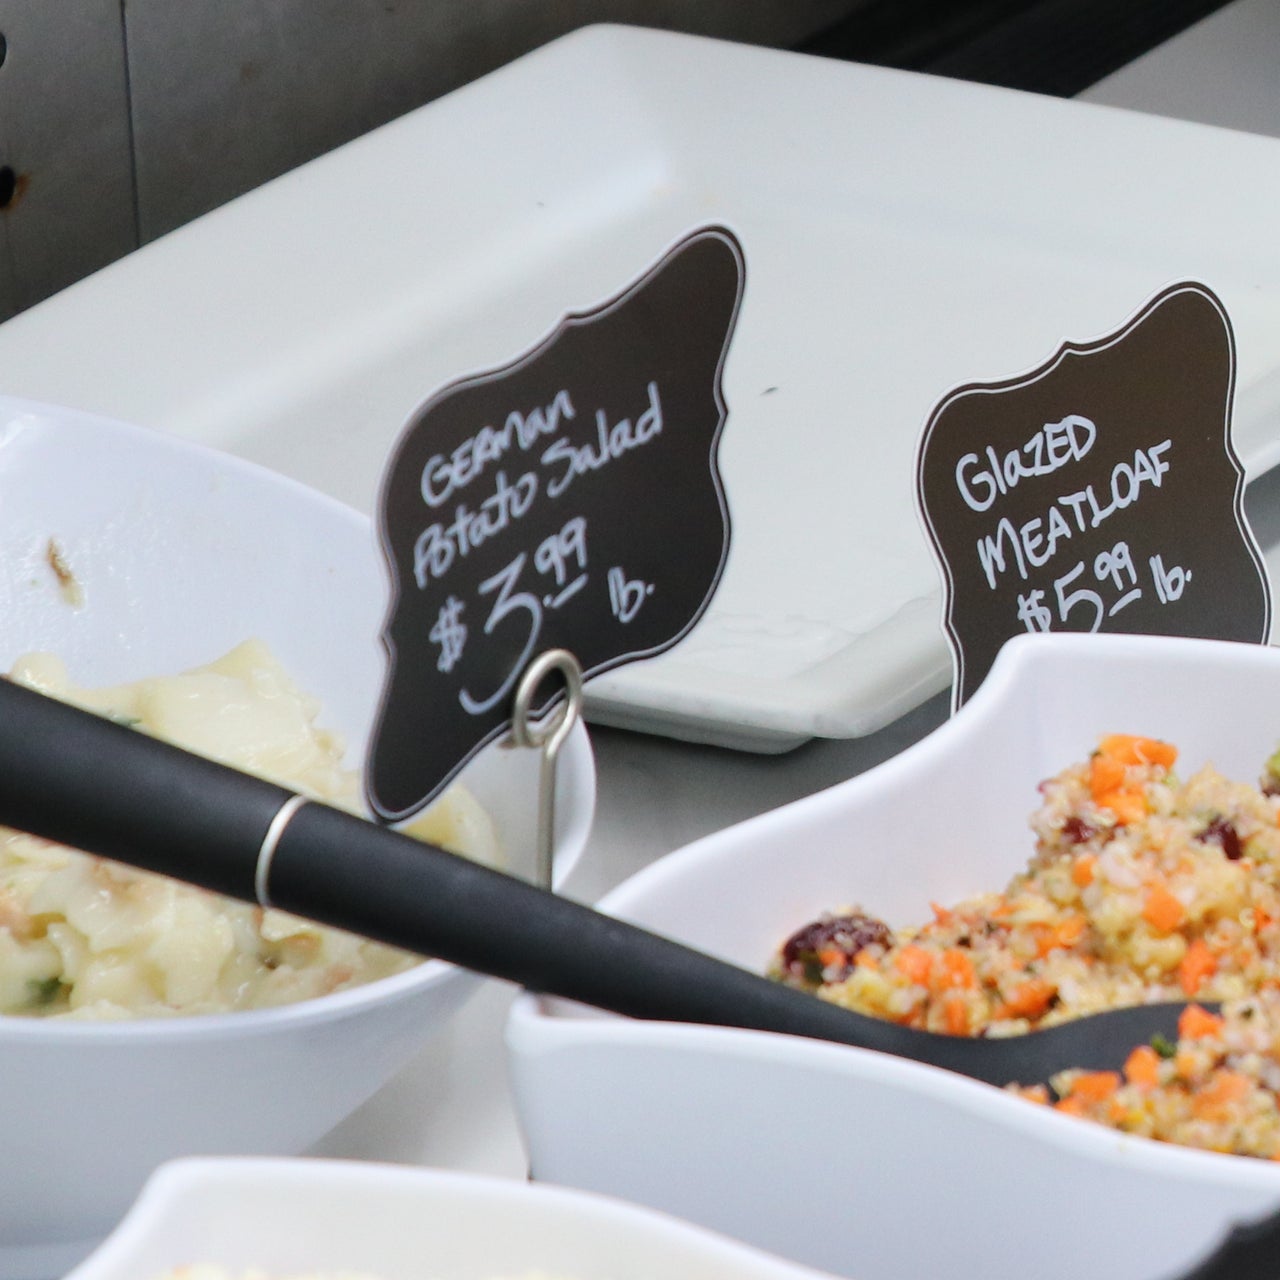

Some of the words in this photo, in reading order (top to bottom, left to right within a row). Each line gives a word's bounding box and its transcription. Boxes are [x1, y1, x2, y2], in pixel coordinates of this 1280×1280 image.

[413, 470, 539, 590] Potato
[540, 380, 664, 499] Salad
[976, 438, 1172, 591] MEATLOAF
[607, 566, 656, 624] lb.
[1149, 554, 1193, 605] lb.
